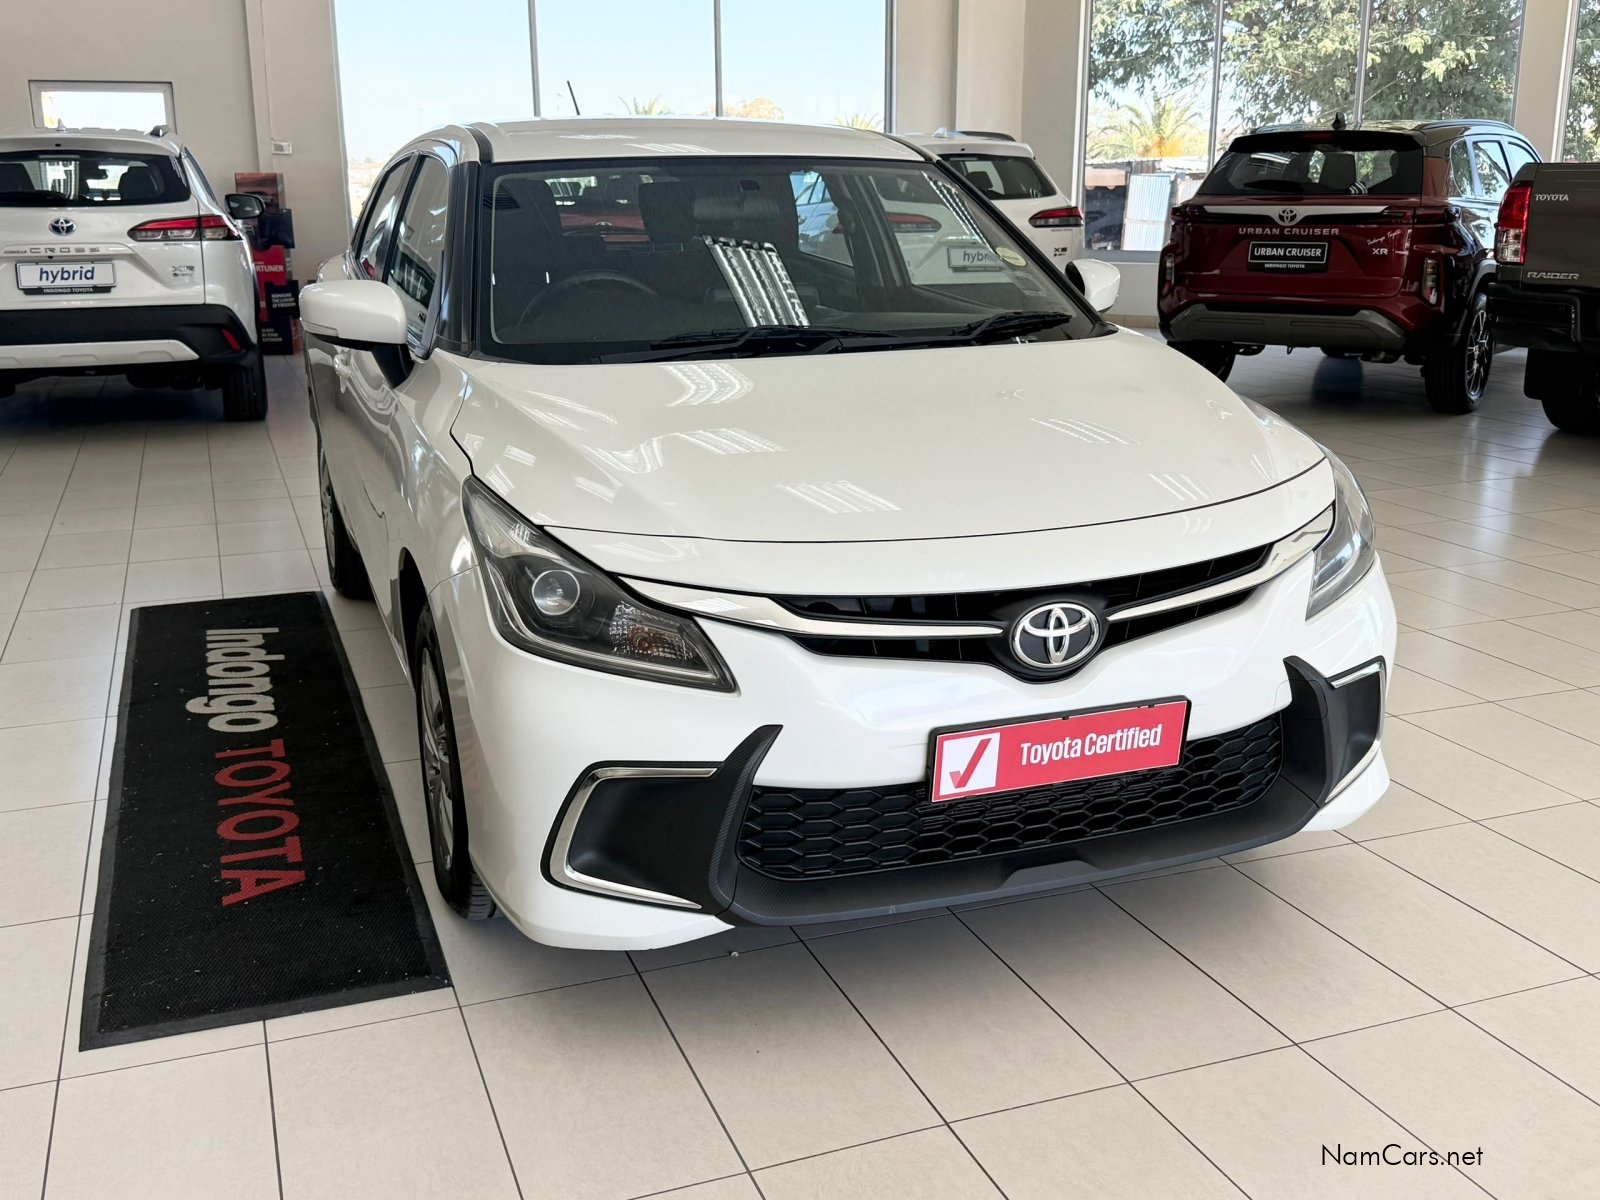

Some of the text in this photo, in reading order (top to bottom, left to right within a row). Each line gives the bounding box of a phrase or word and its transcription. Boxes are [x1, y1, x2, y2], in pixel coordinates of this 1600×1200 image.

[1535, 193, 1569, 202] TOYOTA
[1238, 227, 1340, 236] URBAN CRUISER
[963, 250, 991, 264] hybr
[1254, 247, 1322, 257] URBAN CRUISER
[1371, 248, 1389, 256] XR
[39, 266, 96, 284] hybrid
[1527, 271, 1580, 280] RAIDER
[1020, 723, 1162, 766] Toyota Certified
[185, 627, 306, 907] Indongo TOYOTA
